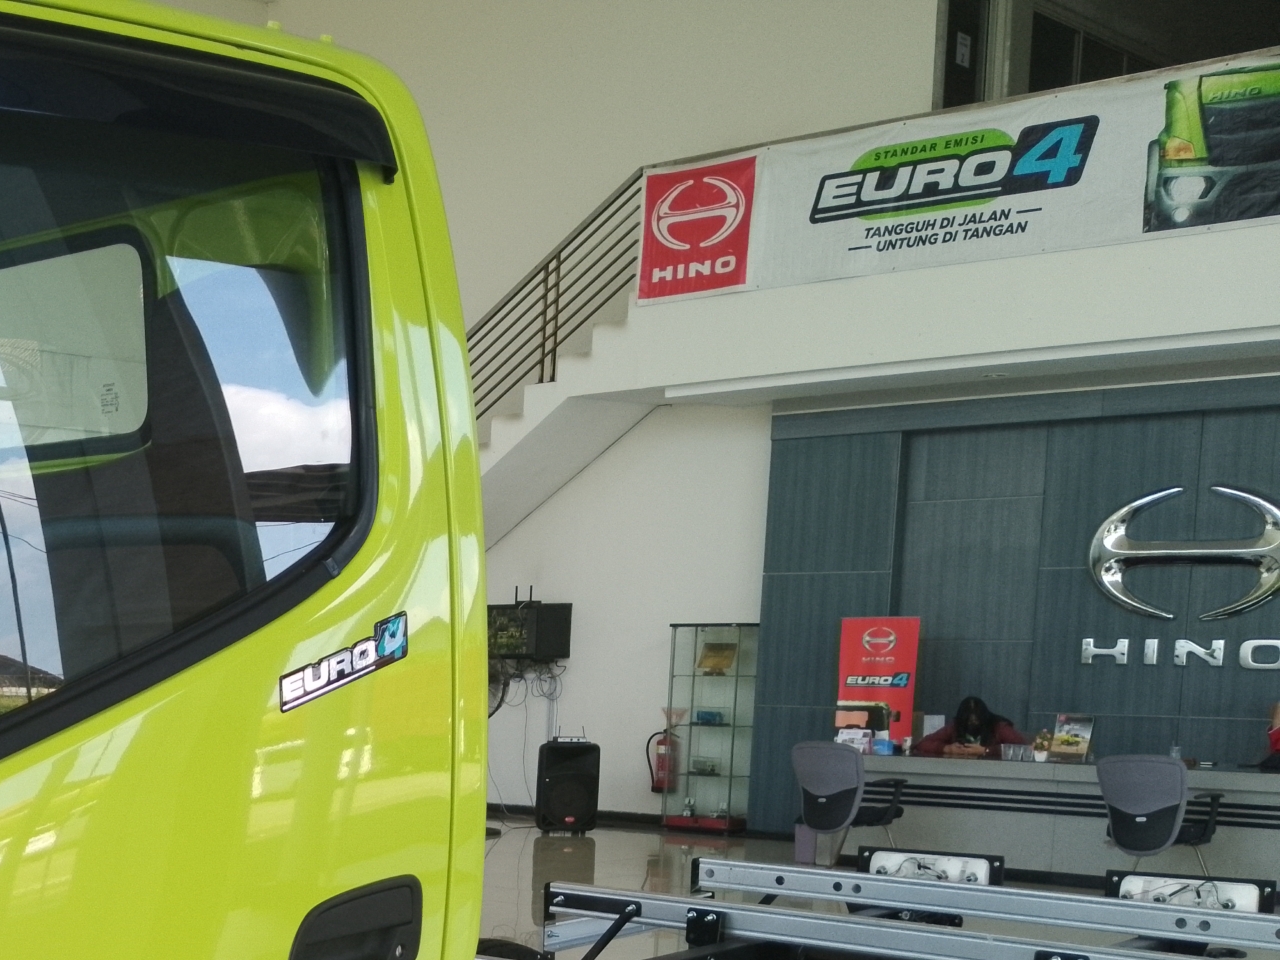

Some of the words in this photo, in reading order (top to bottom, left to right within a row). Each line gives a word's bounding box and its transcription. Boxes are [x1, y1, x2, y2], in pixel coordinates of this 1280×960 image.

[1210, 86, 1261, 101] HINO
[874, 143, 938, 161] STANDAR
[944, 134, 986, 149] EMISI
[863, 217, 937, 240] TANGGUH
[939, 216, 956, 230] DI
[958, 208, 1012, 227] JALAN
[875, 232, 940, 253] UNTUNG
[942, 230, 959, 244] DI
[961, 220, 1029, 241] TANGAN
[651, 255, 737, 283] HINO
[1080, 638, 1280, 670] HINO
